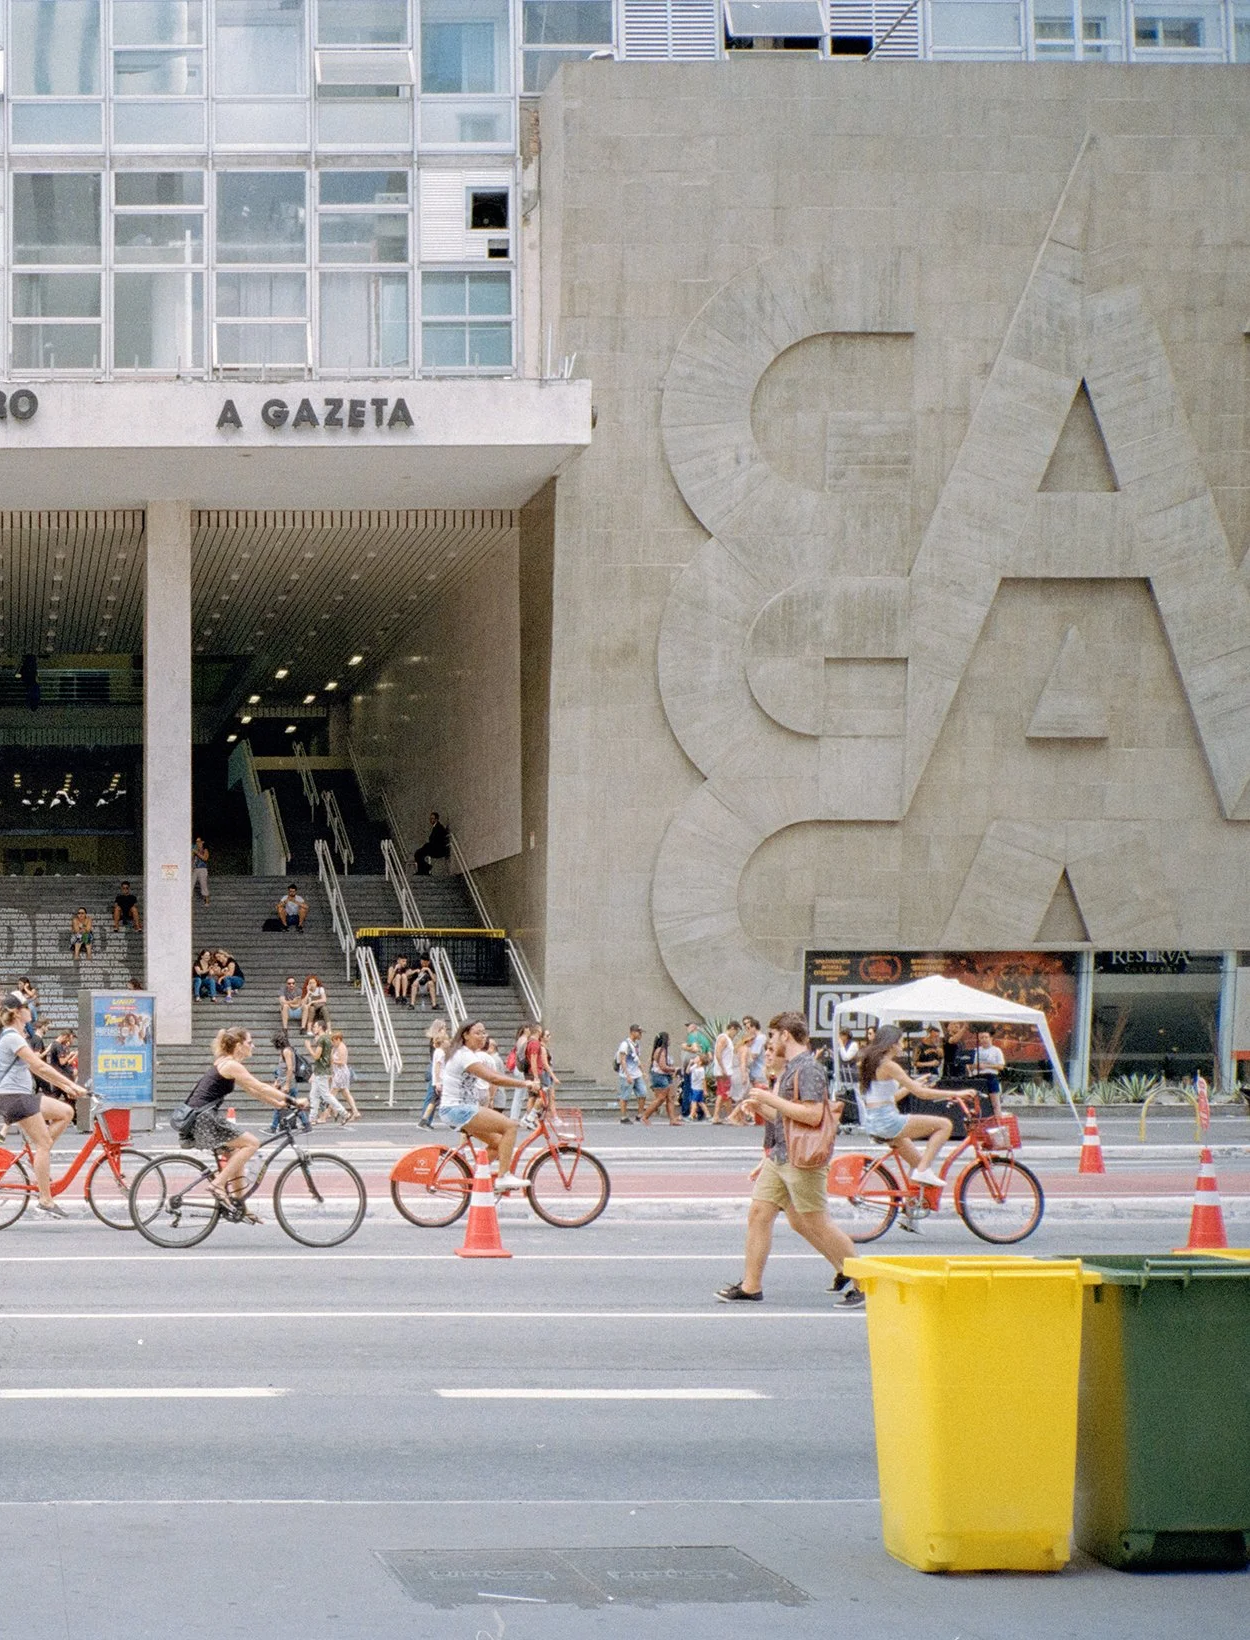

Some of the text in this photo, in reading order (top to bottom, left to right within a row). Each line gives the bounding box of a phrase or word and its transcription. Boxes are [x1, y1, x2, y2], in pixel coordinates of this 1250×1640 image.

[216, 398, 415, 428] A GAZETA
[1111, 951, 1191, 965] RESERVA
